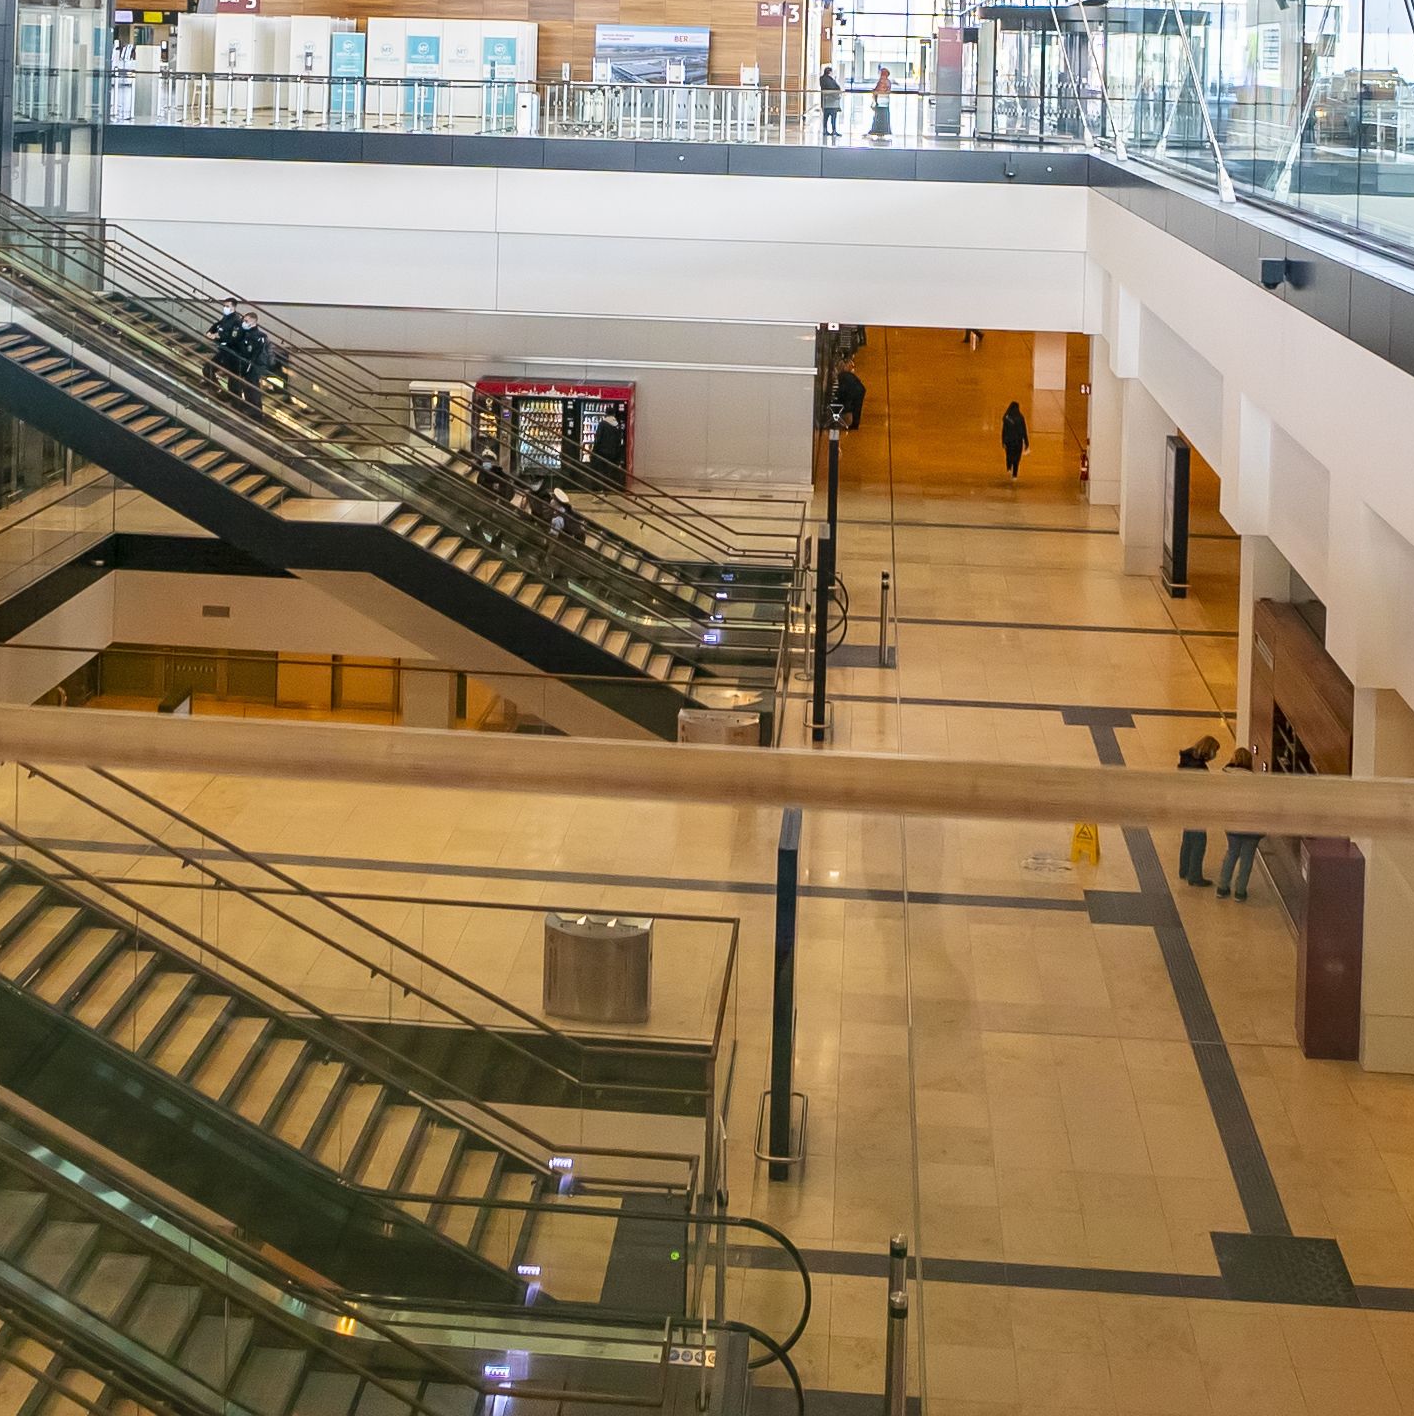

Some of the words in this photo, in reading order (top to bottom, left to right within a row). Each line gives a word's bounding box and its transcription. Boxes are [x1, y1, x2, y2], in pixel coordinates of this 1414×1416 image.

[788, 4, 800, 23] 3
[674, 35, 689, 43] BER
[824, 27, 831, 40] 1
